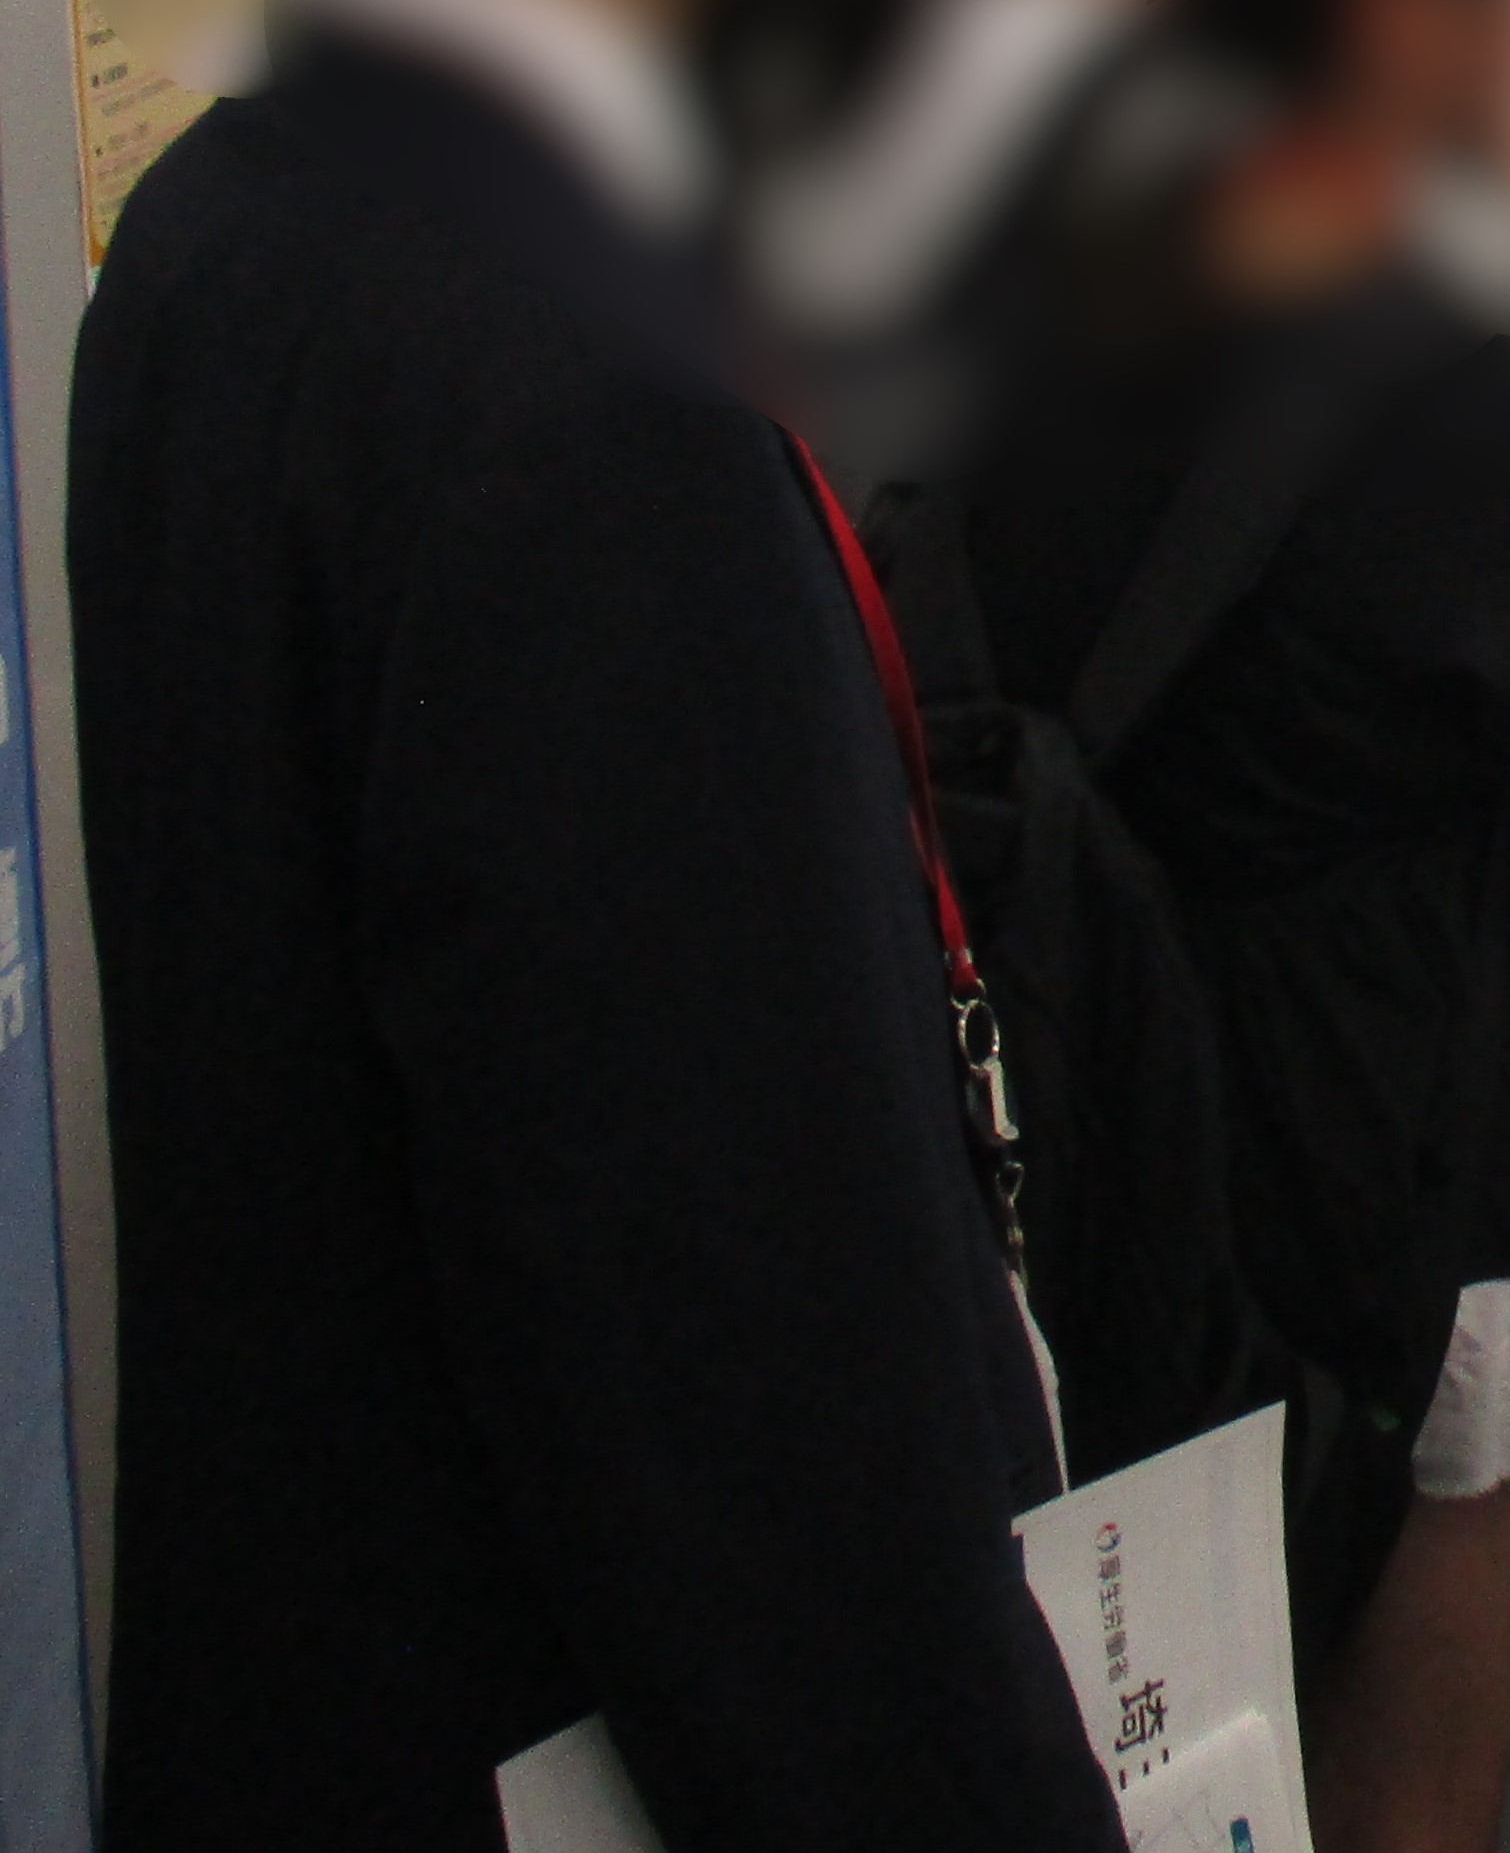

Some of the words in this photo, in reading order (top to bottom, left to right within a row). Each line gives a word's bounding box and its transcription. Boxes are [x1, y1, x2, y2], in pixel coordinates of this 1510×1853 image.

[1097, 1554, 1132, 1685] 厚生労働省
